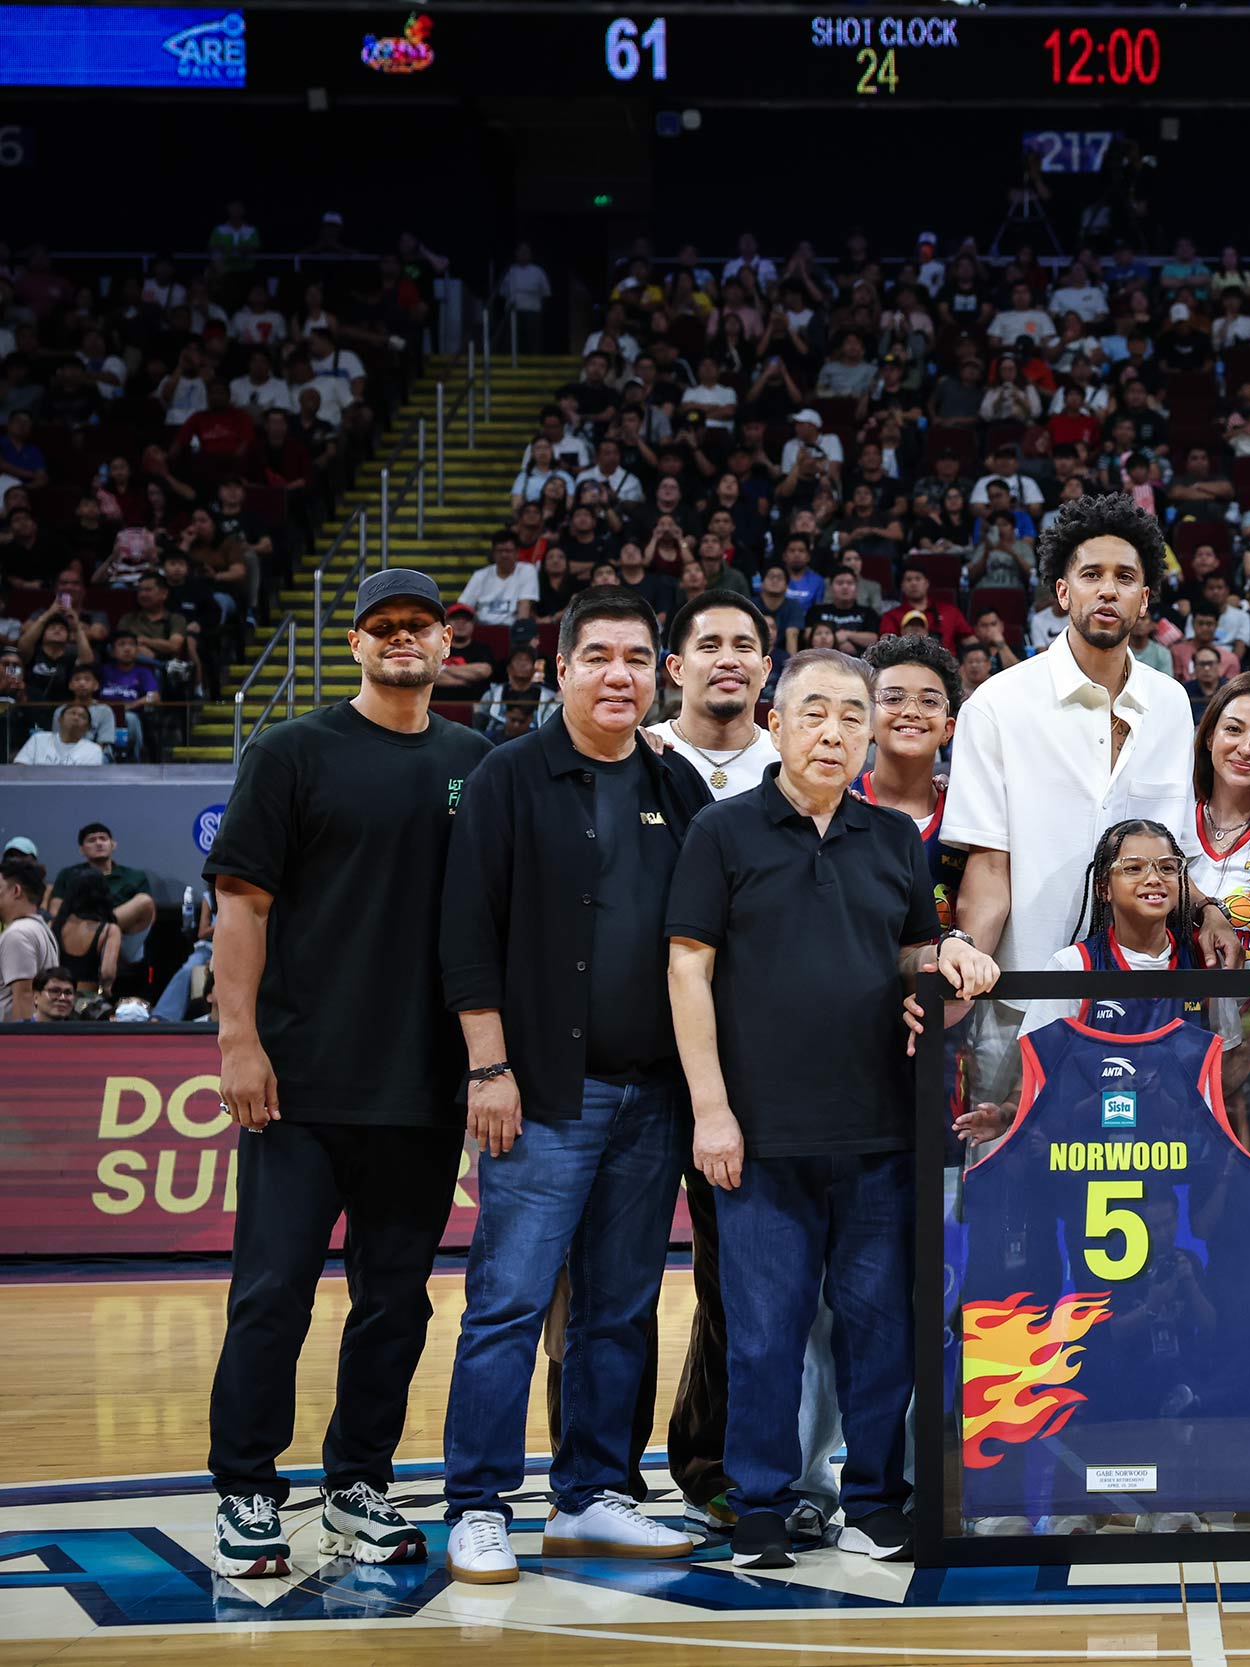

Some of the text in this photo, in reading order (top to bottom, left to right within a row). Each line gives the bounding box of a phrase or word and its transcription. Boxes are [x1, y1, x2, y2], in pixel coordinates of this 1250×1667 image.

[605, 17, 667, 81] 61
[811, 17, 959, 47] SHOT CLOCK
[856, 48, 899, 94] 24
[1043, 28, 1161, 84] 12:00
[1038, 131, 1112, 172] 217
[1102, 1067, 1122, 1077] ANTA
[1108, 1100, 1131, 1112] Sista
[1050, 1141, 1188, 1171] NORWOOD
[1083, 1180, 1149, 1281] 5
